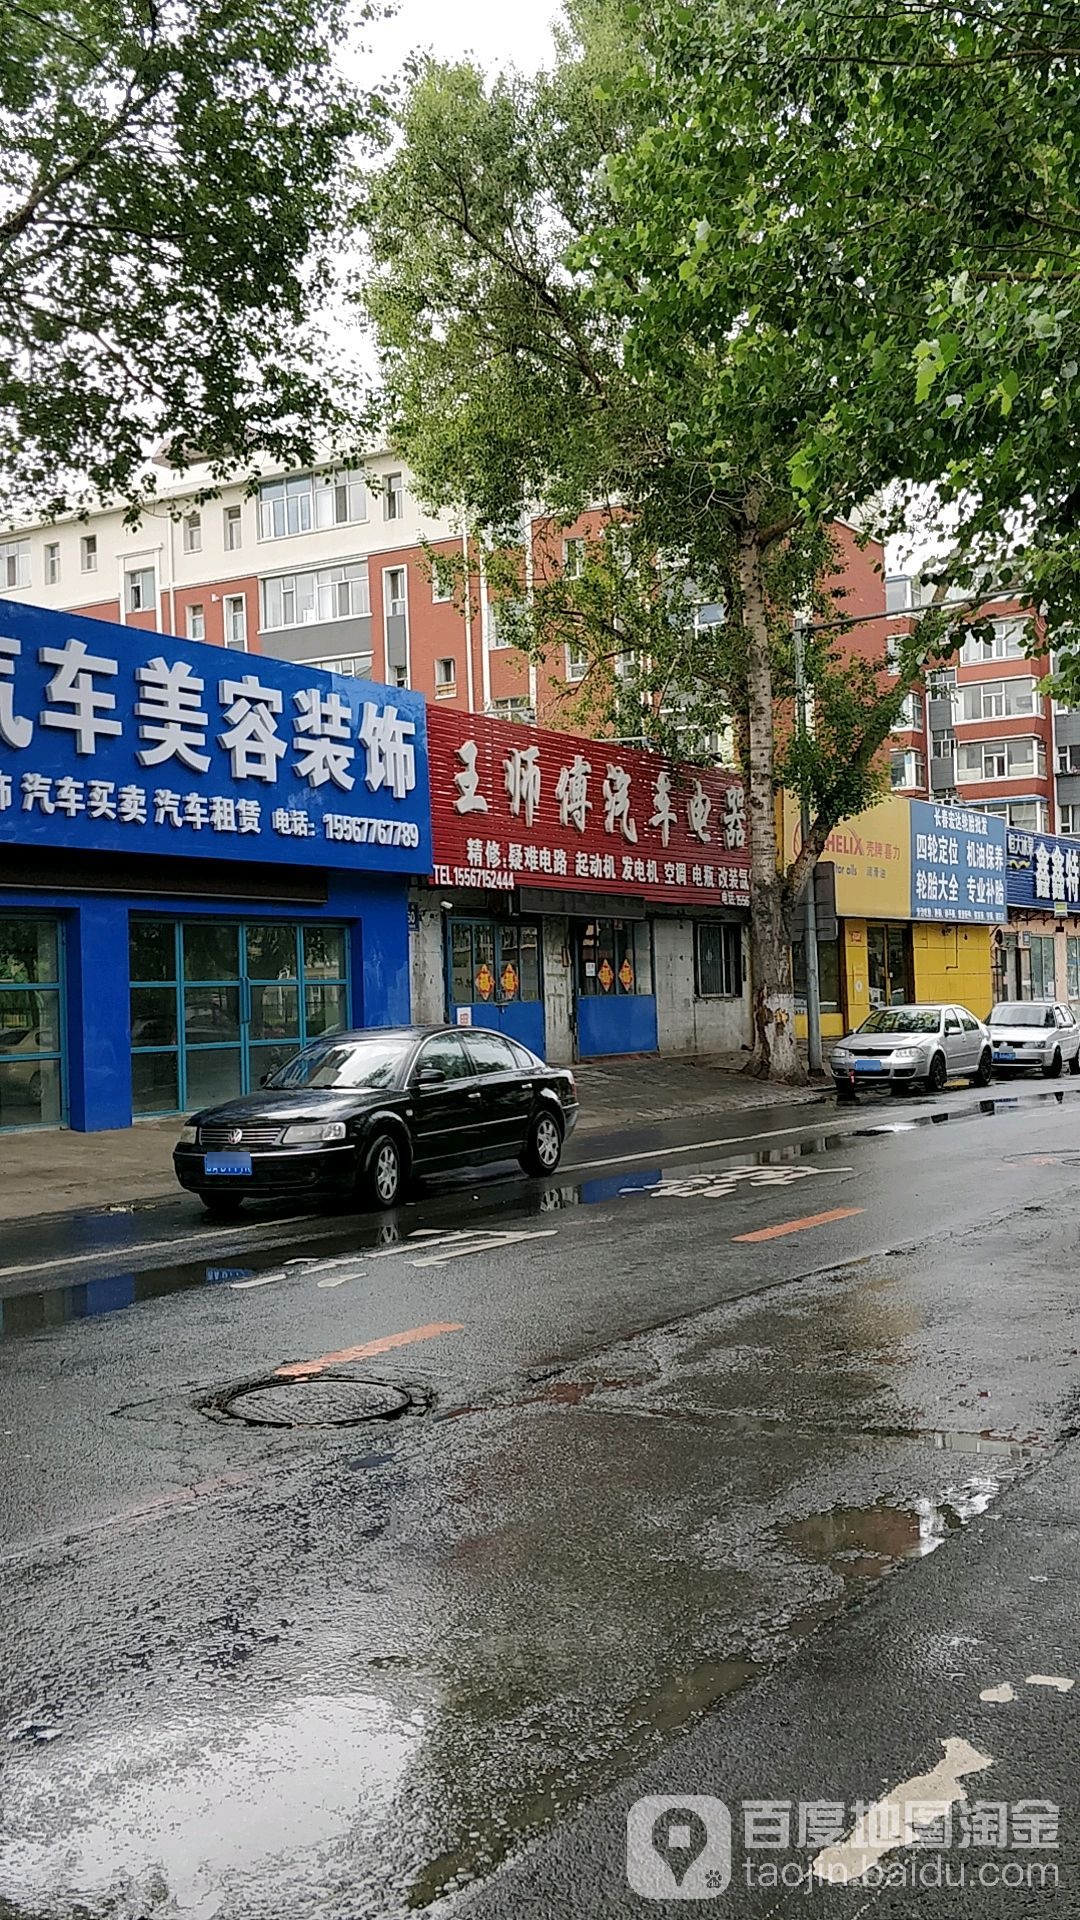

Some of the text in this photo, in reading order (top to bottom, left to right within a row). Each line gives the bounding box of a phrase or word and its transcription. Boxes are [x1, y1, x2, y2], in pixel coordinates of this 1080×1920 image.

[21, 772, 147, 824] 汽车买卖
[154, 789, 261, 834] 汽车租赁
[323, 813, 419, 848] 15567767789
[453, 740, 748, 850] 王师傅汽车电器
[575, 851, 616, 879] 起动机
[622, 855, 659, 883] 发电机
[664, 862, 687, 885] 空调
[692, 864, 715, 888] 电瓶
[916, 833, 959, 865] 四轮定位
[966, 840, 1004, 871] 机油保养
[916, 869, 1004, 905] 轮胎大全 专业补胎
